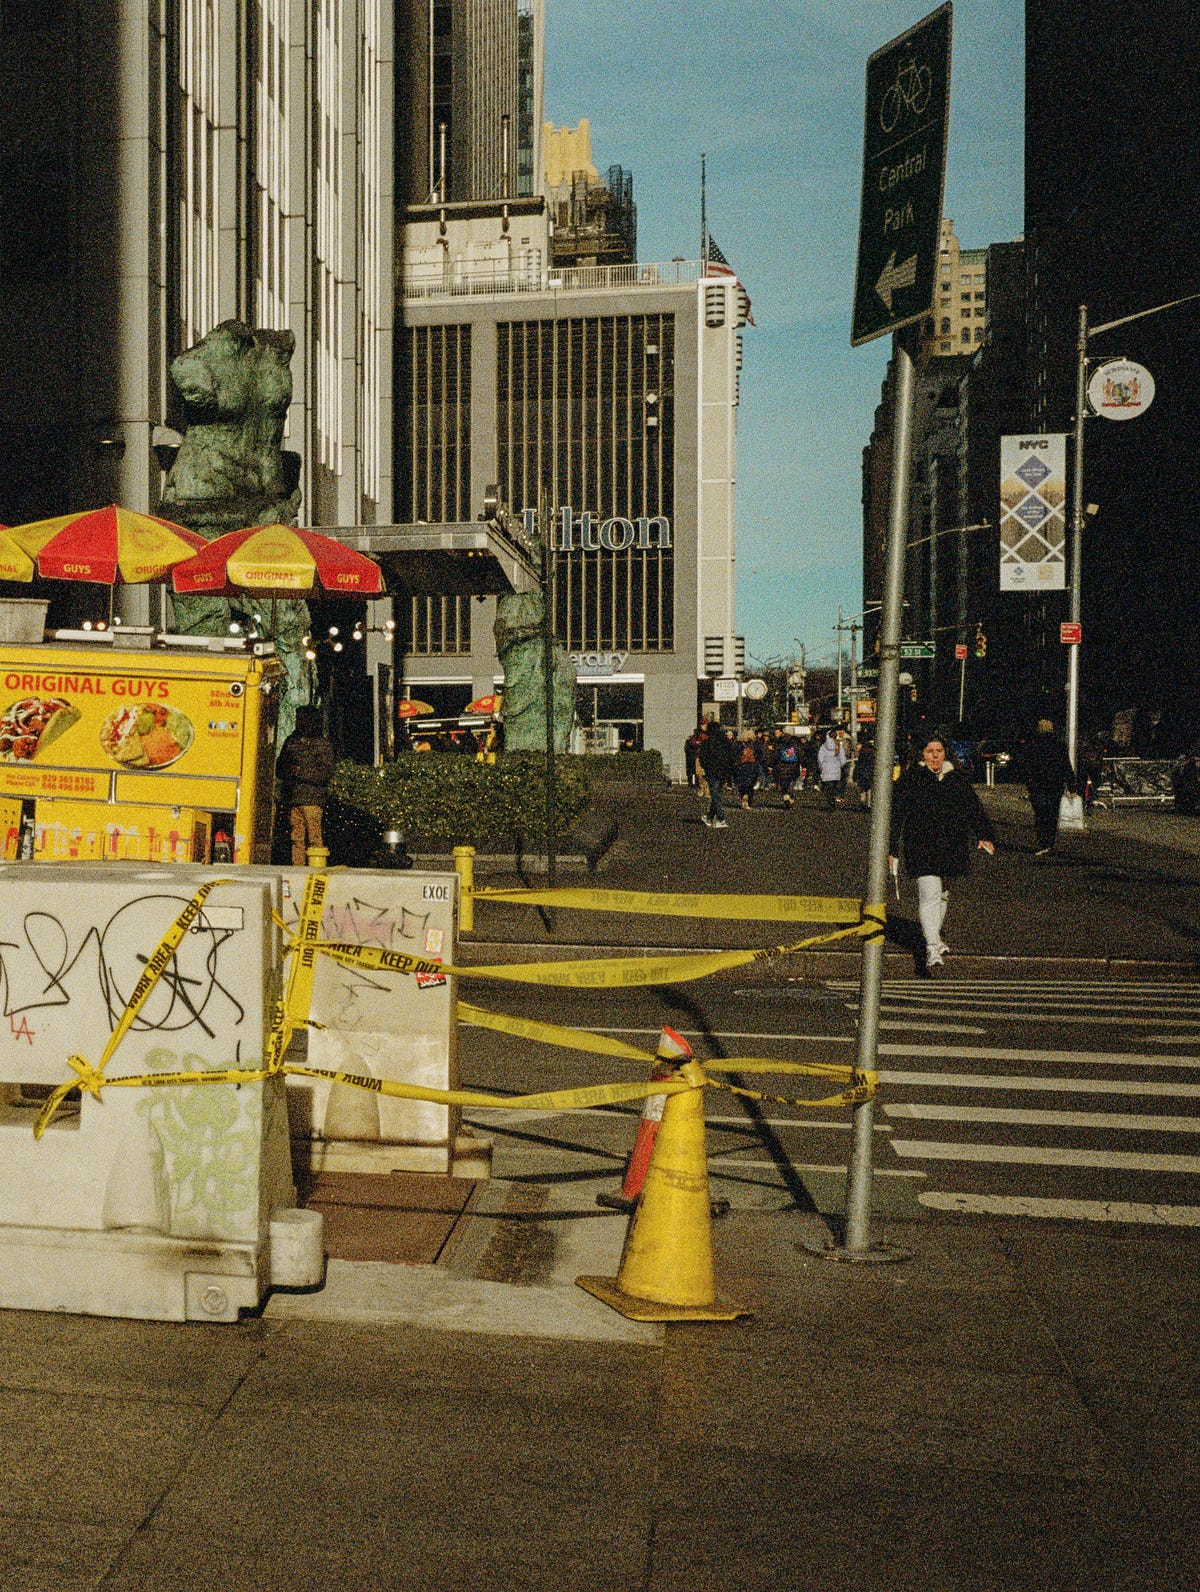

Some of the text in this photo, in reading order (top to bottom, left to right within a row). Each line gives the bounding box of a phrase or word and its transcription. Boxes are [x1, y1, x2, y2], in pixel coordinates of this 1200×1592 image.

[879, 143, 927, 192] Central
[883, 199, 914, 235] Park
[1019, 440, 1049, 450] NYC
[63, 563, 91, 575] GUYS
[193, 573, 213, 584] GUYS
[245, 570, 295, 581] ORIGINAL
[336, 573, 360, 584] GUYS
[568, 652, 629, 673] ercury
[4, 673, 106, 695] ORIGINAL
[111, 679, 170, 698] GUYS
[309, 879, 325, 907] AREA
[422, 886, 449, 899] EXOE
[304, 919, 319, 942] KEE
[127, 974, 153, 1010] WORK
[148, 942, 175, 976] AREA
[176, 900, 200, 930] KEEP
[302, 948, 315, 970] OUT
[380, 951, 413, 970] KEEP
[414, 960, 442, 974] OUT
[341, 1073, 383, 1092] WORK
